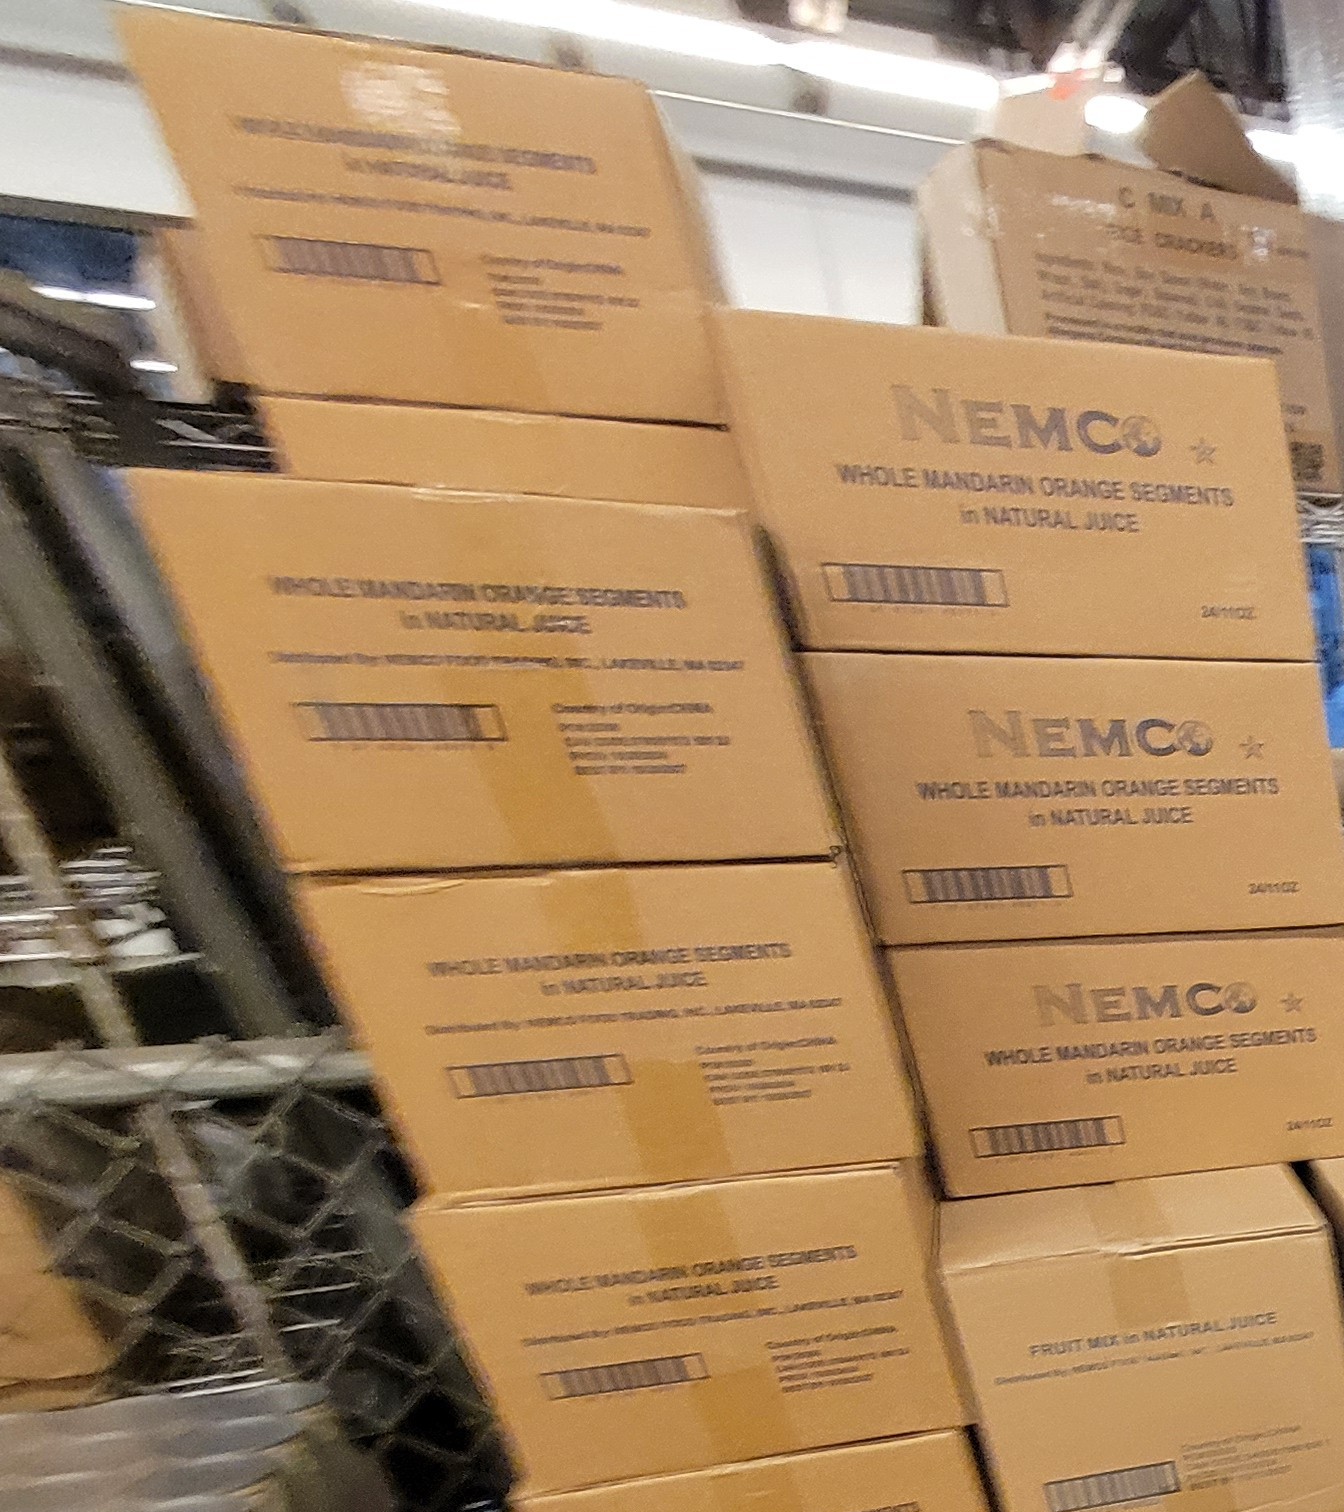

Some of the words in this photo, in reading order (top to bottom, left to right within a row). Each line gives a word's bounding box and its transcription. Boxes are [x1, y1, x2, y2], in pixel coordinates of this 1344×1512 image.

[890, 384, 1163, 457] NEMCO
[835, 463, 919, 488] WHOLE
[922, 468, 1034, 495] MANDARIN
[1040, 476, 1126, 501] ORANGE
[1130, 481, 1235, 507] SEGMENTS
[984, 506, 1078, 529] NATURAL
[1086, 511, 1140, 533] JUICE
[967, 709, 1215, 758] NEMCO
[916, 780, 990, 800] WHOLE
[995, 780, 1097, 799] MANDARIN
[1102, 778, 1178, 798] ORANGE
[1183, 777, 1280, 796] SEGMENTS
[1049, 808, 1138, 827] NATURAL
[1142, 806, 1193, 825] JUICE
[1031, 981, 1259, 1027] NEMCO
[985, 1047, 1052, 1067] WHOLE
[1056, 1040, 1150, 1062] MANDARIN
[1153, 1034, 1225, 1054] ORANGE
[1229, 1027, 1317, 1048] SEGMENTS
[1106, 1062, 1185, 1083] NATURAL
[1189, 1058, 1239, 1078] JUICE
[1028, 1337, 1082, 1357] FRUIT
[1087, 1334, 1119, 1349] MIX
[1142, 1321, 1225, 1341] NATURAL
[1228, 1311, 1279, 1331] JUICE
